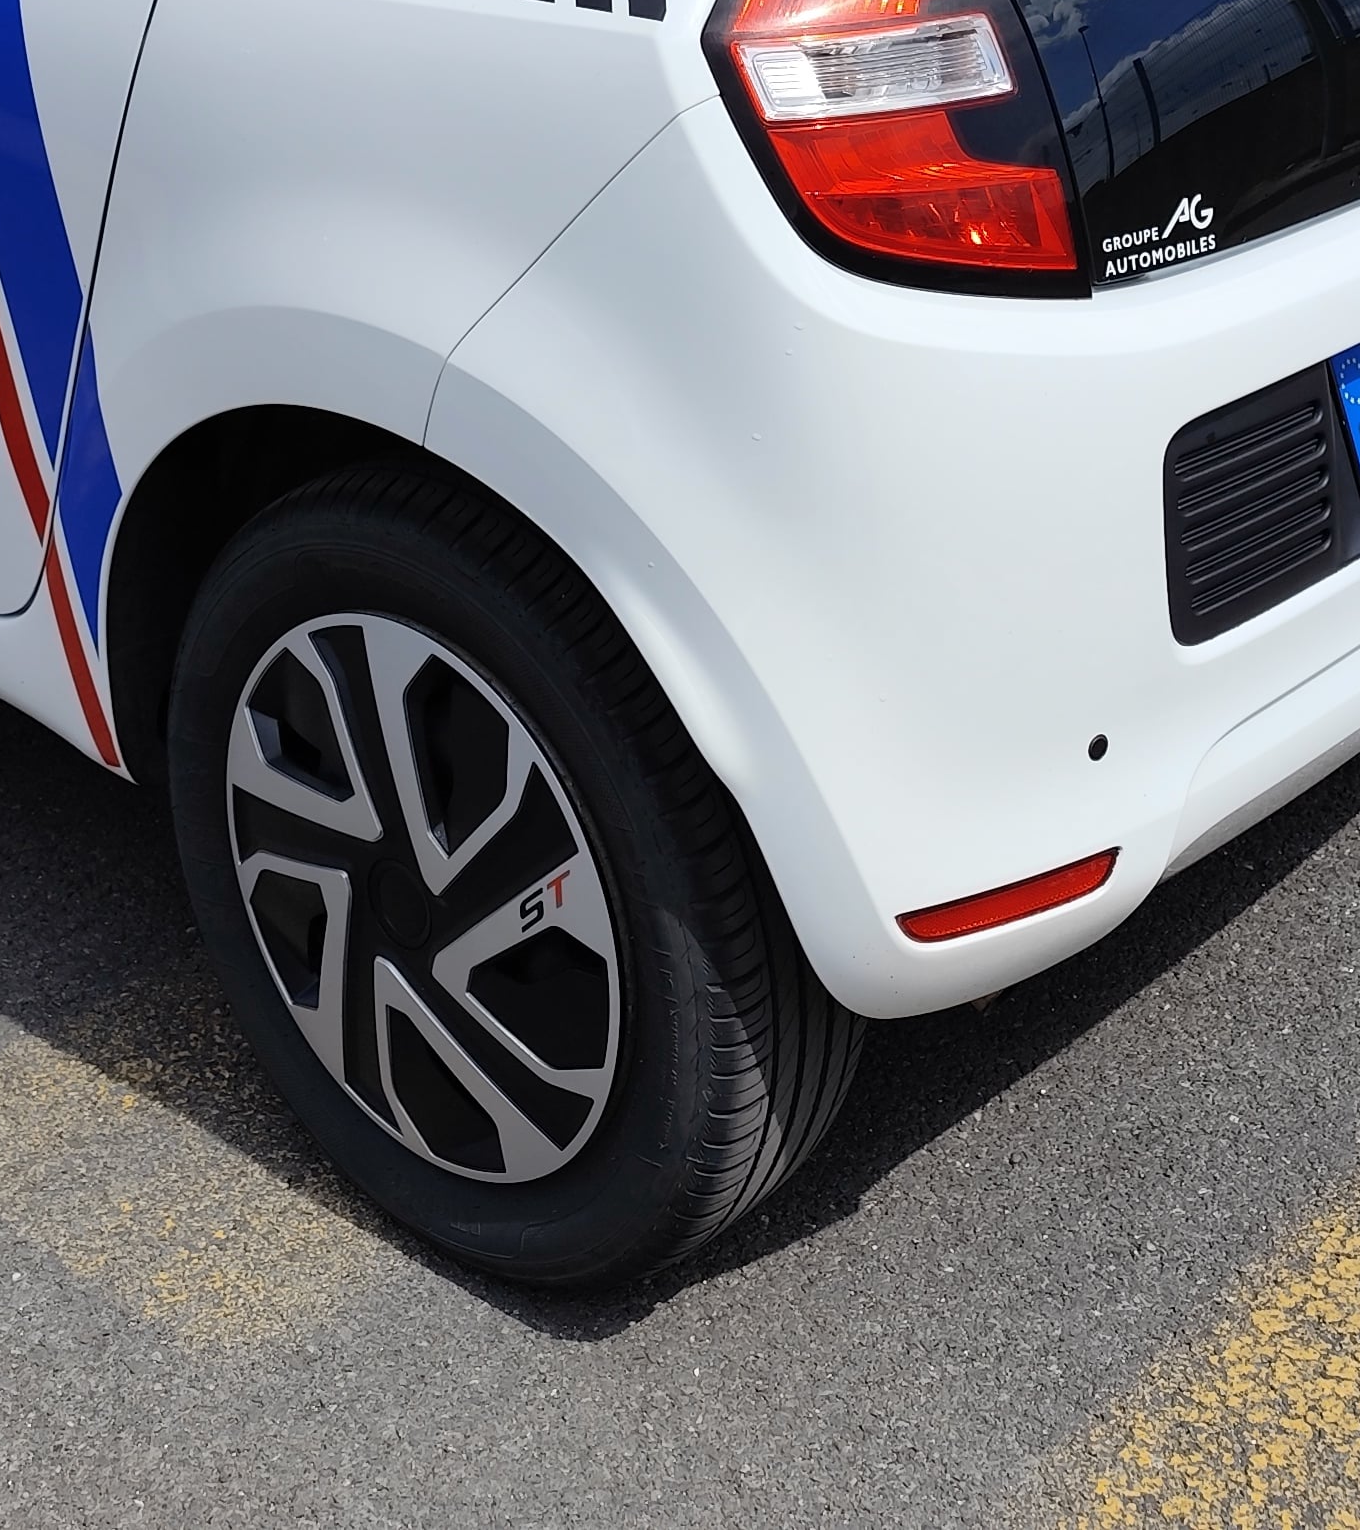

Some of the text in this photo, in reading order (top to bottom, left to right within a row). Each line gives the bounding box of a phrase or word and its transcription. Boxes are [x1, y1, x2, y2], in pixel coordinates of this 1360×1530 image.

[1102, 193, 1214, 253] GROUPE AG
[1105, 234, 1216, 278] AUTOMOBILES
[519, 869, 571, 934] ST
